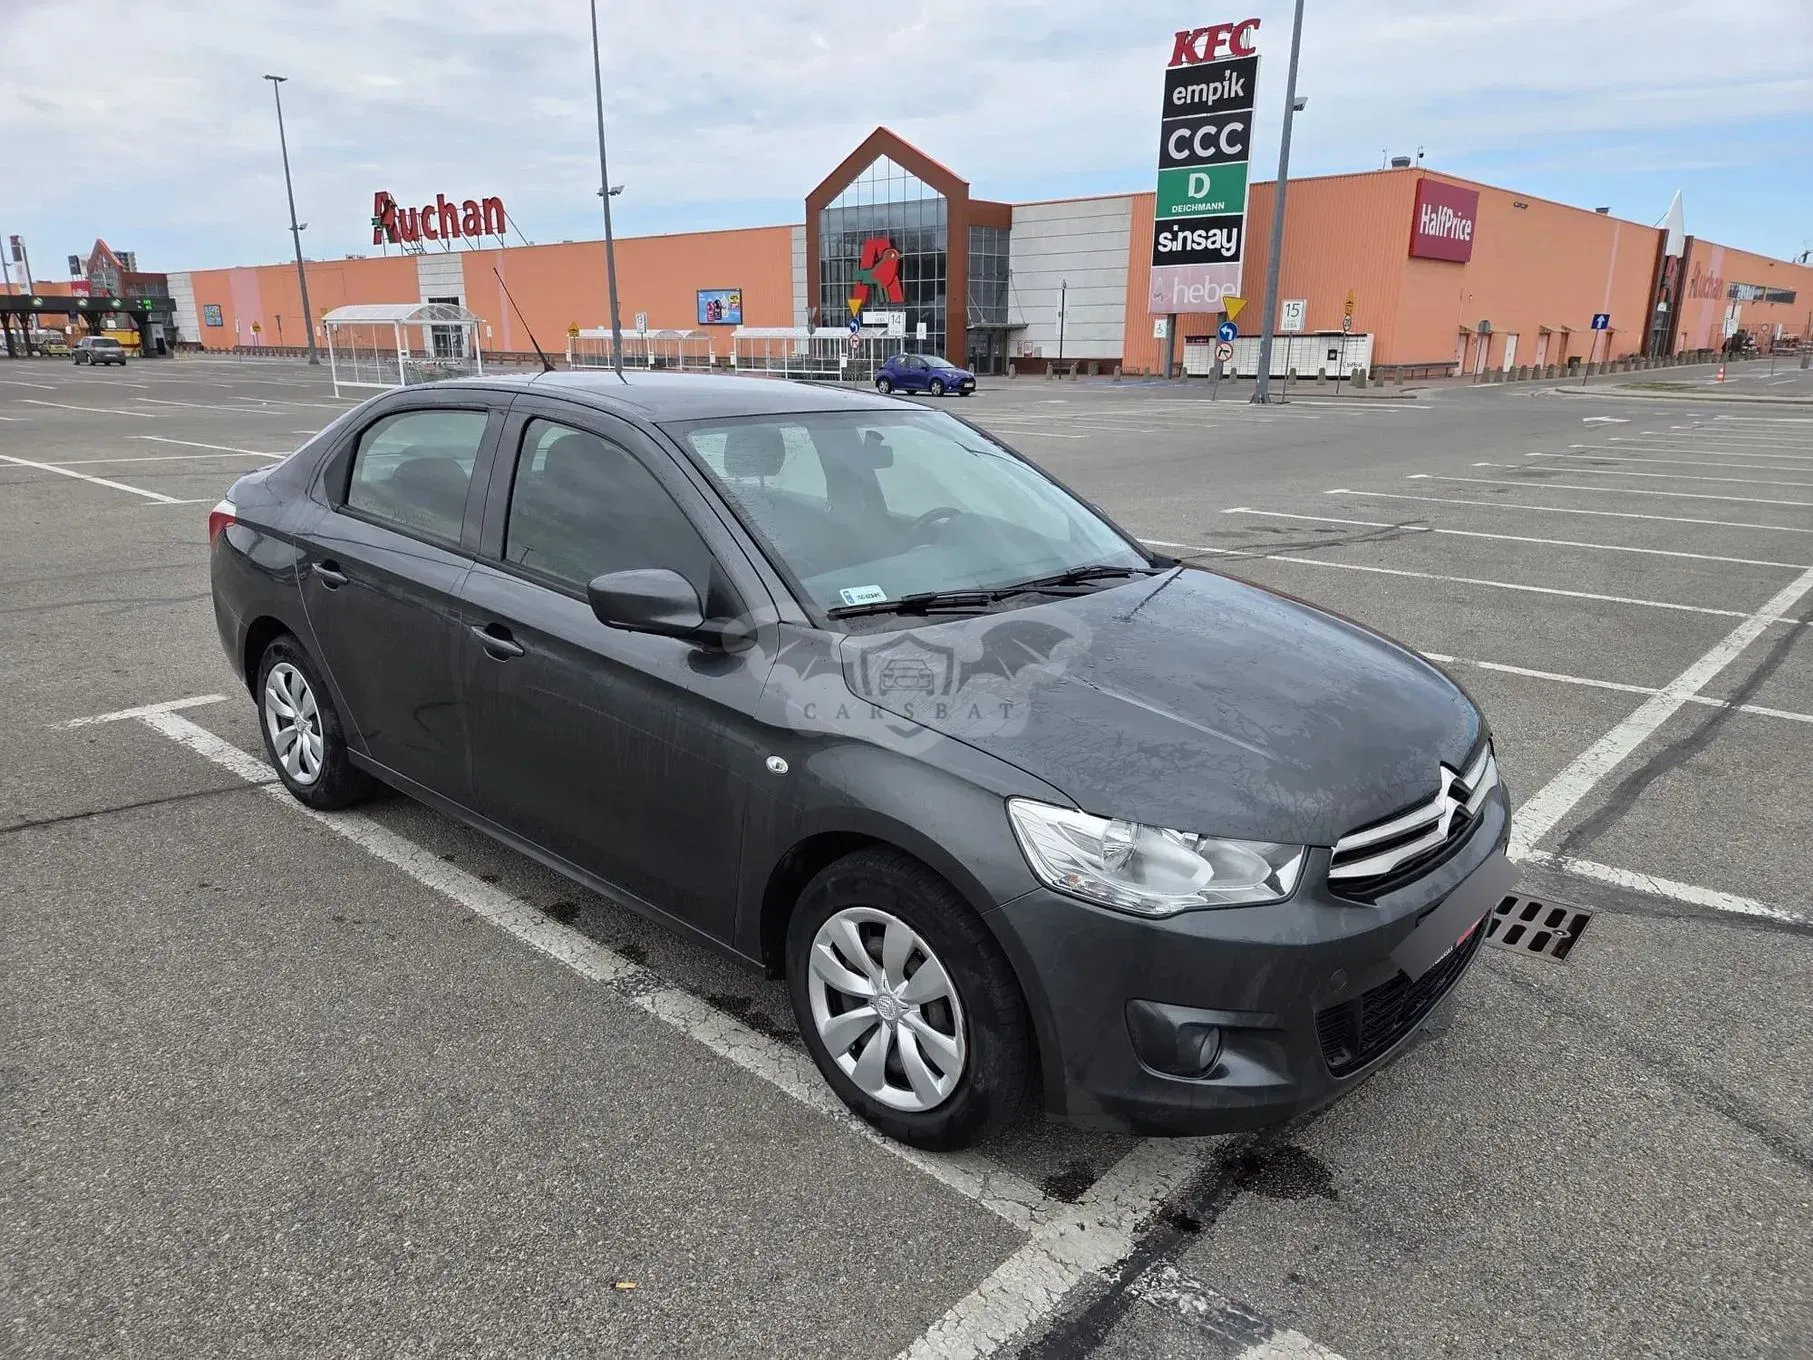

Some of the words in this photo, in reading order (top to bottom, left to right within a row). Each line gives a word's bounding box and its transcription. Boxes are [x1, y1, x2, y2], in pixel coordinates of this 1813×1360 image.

[1167, 17, 1262, 67] KFC
[1172, 69, 1246, 106] empik
[1168, 121, 1244, 160] CCC
[1187, 172, 1211, 199] D
[372, 190, 507, 246] Auchan
[1171, 201, 1226, 214] DEICHMANN
[1419, 203, 1472, 242] HalfPrice
[1157, 224, 1238, 257] sinsay
[1172, 274, 1237, 305] hebe
[890, 314, 901, 325] 14
[1285, 303, 1301, 318] 15
